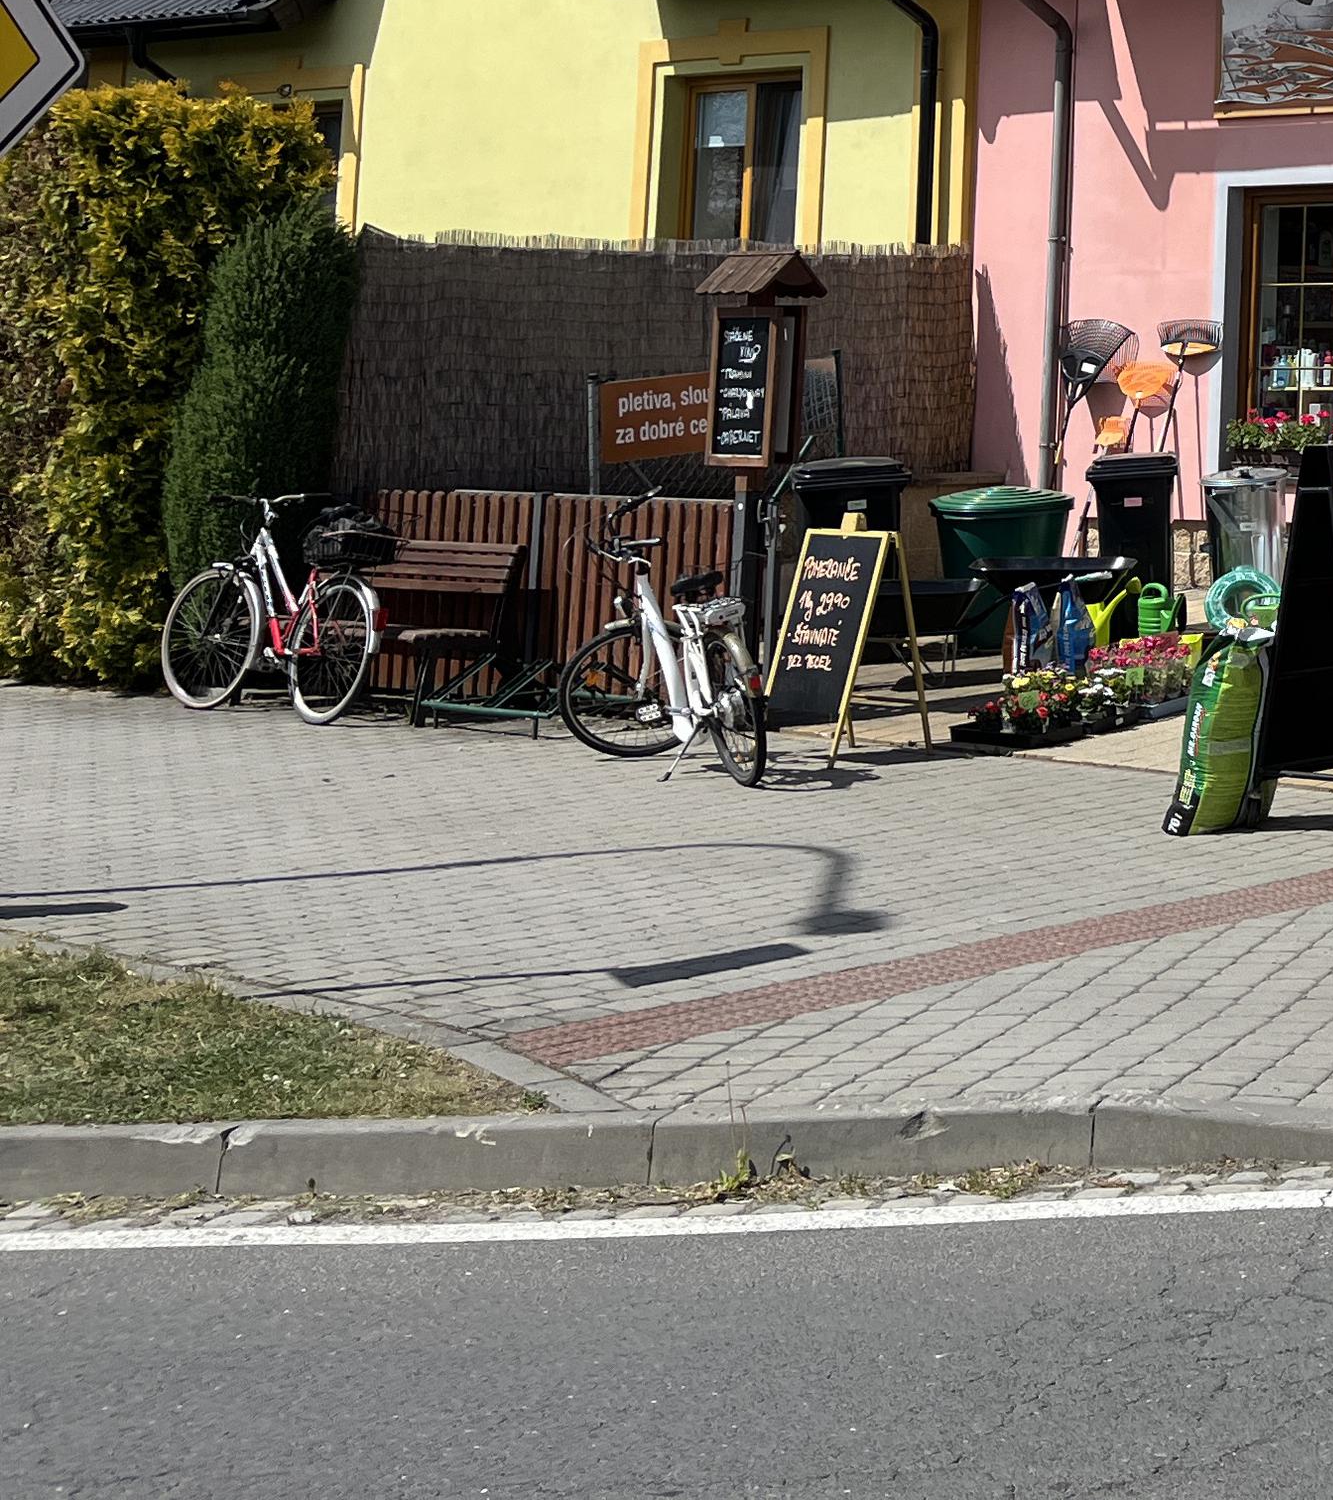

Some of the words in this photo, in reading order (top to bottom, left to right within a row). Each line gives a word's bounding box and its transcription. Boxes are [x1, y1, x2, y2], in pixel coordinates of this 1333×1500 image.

[618, 389, 677, 418] pletiva,
[615, 427, 635, 445] za
[640, 416, 685, 442] dobré
[1168, 816, 1181, 833] 70
